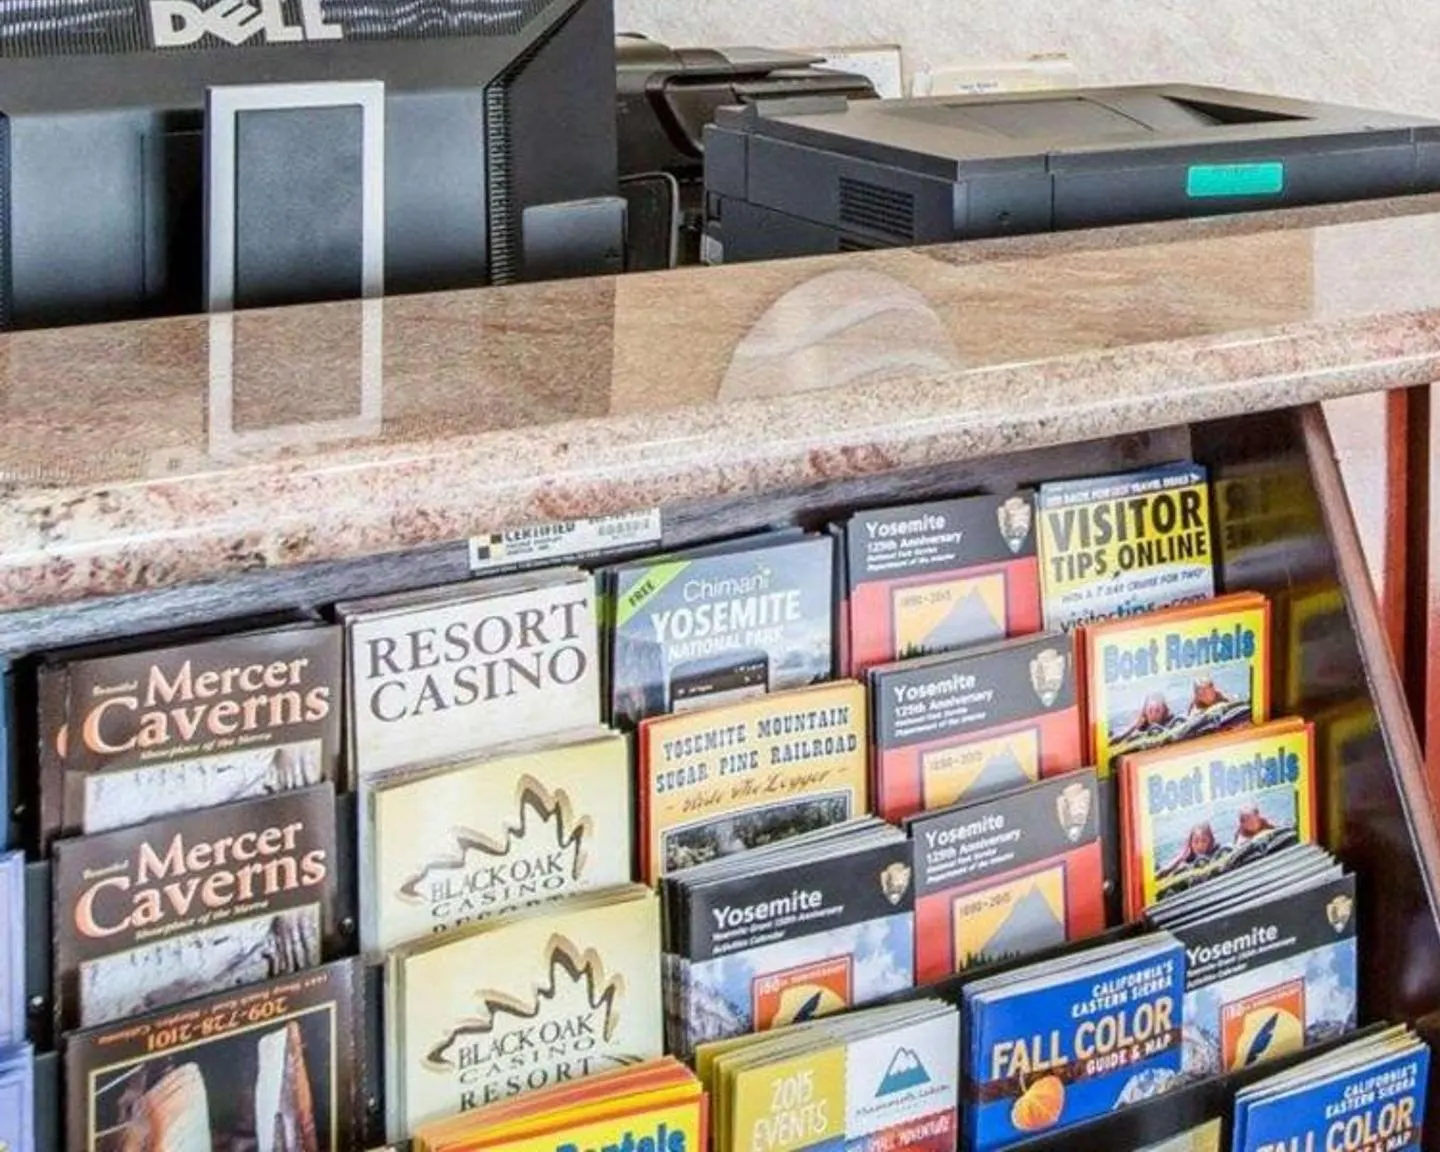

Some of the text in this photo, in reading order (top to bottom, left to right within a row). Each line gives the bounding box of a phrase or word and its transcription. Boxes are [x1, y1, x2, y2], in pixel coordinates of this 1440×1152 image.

[866, 513, 946, 539] Yosemite
[1048, 489, 1202, 553] VISITOR
[1051, 530, 1207, 583] TIPS ONLINE
[629, 578, 656, 608] FREE
[683, 568, 771, 603] Chimani
[365, 599, 587, 679] RESORT
[651, 589, 801, 644] YOSEMITE
[1103, 623, 1255, 684] Boat Rentals
[144, 657, 309, 708] Mercer
[370, 645, 587, 722] CASINO
[893, 674, 976, 703] Yosemite
[83, 686, 329, 754] Caverns
[663, 706, 850, 761] YOSEMITE MOUNTAIN
[656, 733, 857, 793] SUGAR PINE RAILROAD
[1147, 746, 1300, 815] Boat Rentals
[135, 822, 304, 887] Mercer
[925, 814, 1005, 848] Yosemite
[74, 850, 327, 938] Caverns
[430, 851, 564, 903] BLACK OAK
[431, 875, 566, 918] CASINO
[712, 889, 823, 930] Yosemite
[1186, 924, 1279, 966] Yosemite
[1071, 992, 1128, 1018] EASTERN
[1132, 975, 1173, 1000] SIERRA
[1092, 960, 1174, 998] CALIFORNIA'S
[457, 1012, 595, 1071] BLACK OAK
[459, 1037, 595, 1085] CASINO
[990, 1029, 1069, 1081] FALL
[1074, 997, 1174, 1060] COLOR
[1086, 1033, 1172, 1076] GUIDE & MAP
[459, 1055, 593, 1113] RESORT
[770, 1069, 816, 1114] 2015
[1325, 1078, 1416, 1120] EASTERN SIERRA
[1343, 1062, 1418, 1099] CALIFORNIA'S
[752, 1098, 829, 1152] EVENTS
[1326, 1096, 1415, 1152] COLOR
